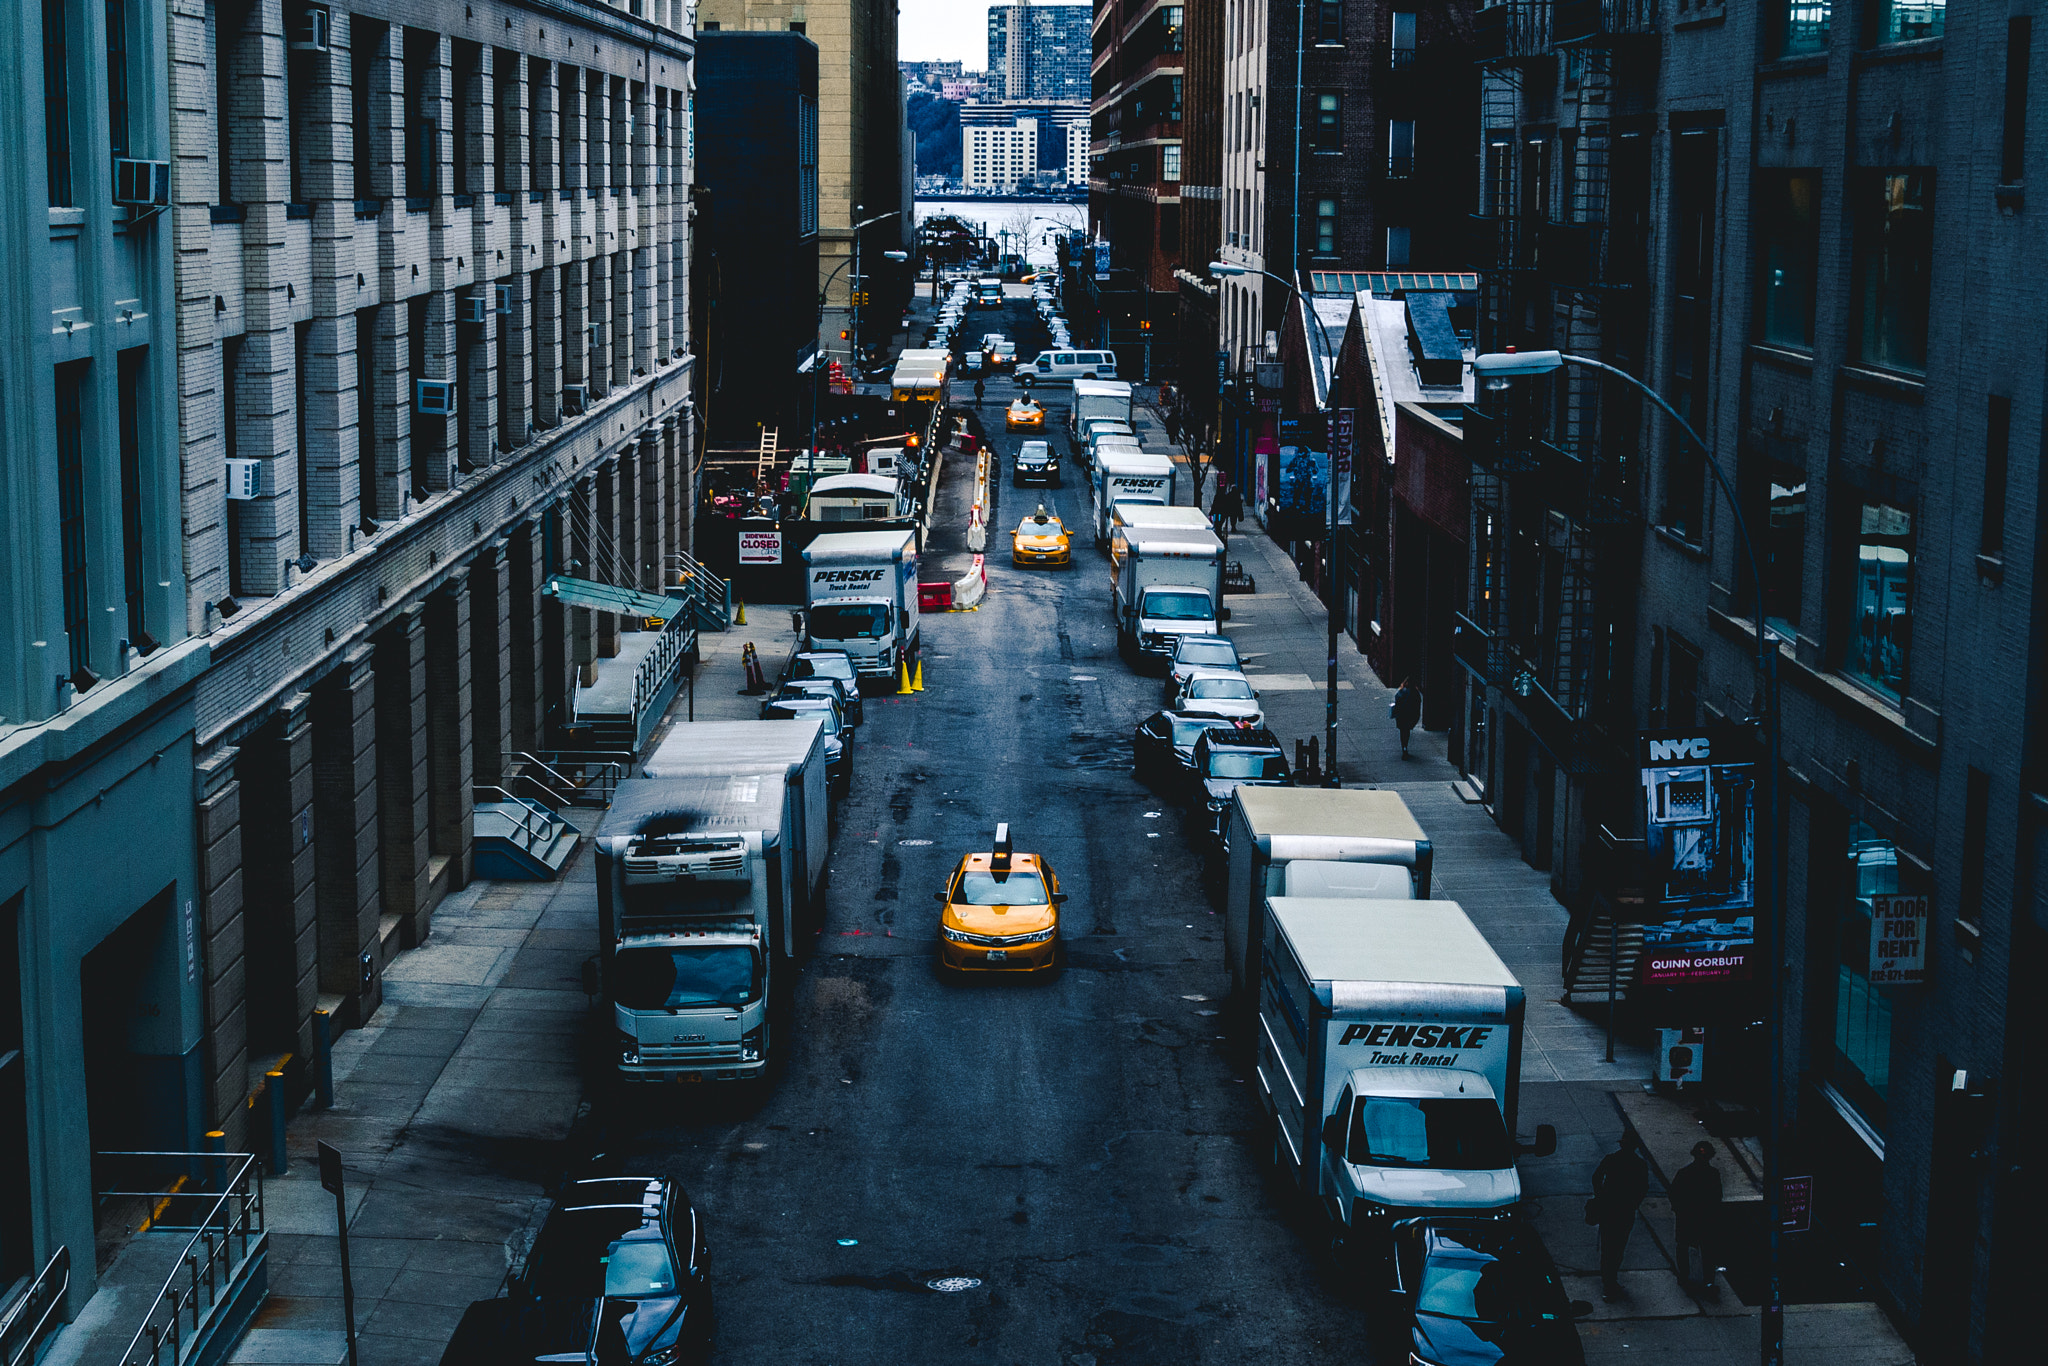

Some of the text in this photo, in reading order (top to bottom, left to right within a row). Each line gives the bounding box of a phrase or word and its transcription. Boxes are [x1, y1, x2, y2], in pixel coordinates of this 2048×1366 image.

[1112, 478, 1165, 488] PENSKE
[741, 540, 780, 548] CLOSED
[813, 569, 885, 583] PENSKE
[1650, 737, 1711, 761] NYC
[1875, 900, 1926, 918] FLOOR
[1883, 920, 1915, 938] FOR
[1878, 940, 1919, 958] RENT
[1651, 956, 1745, 970] QUINN GORBUTT
[1651, 971, 1677, 979] JANUARY
[673, 1034, 706, 1042] ISUZU
[1338, 1023, 1493, 1049] PENSKE
[1369, 1051, 1459, 1067] Truck Rental
